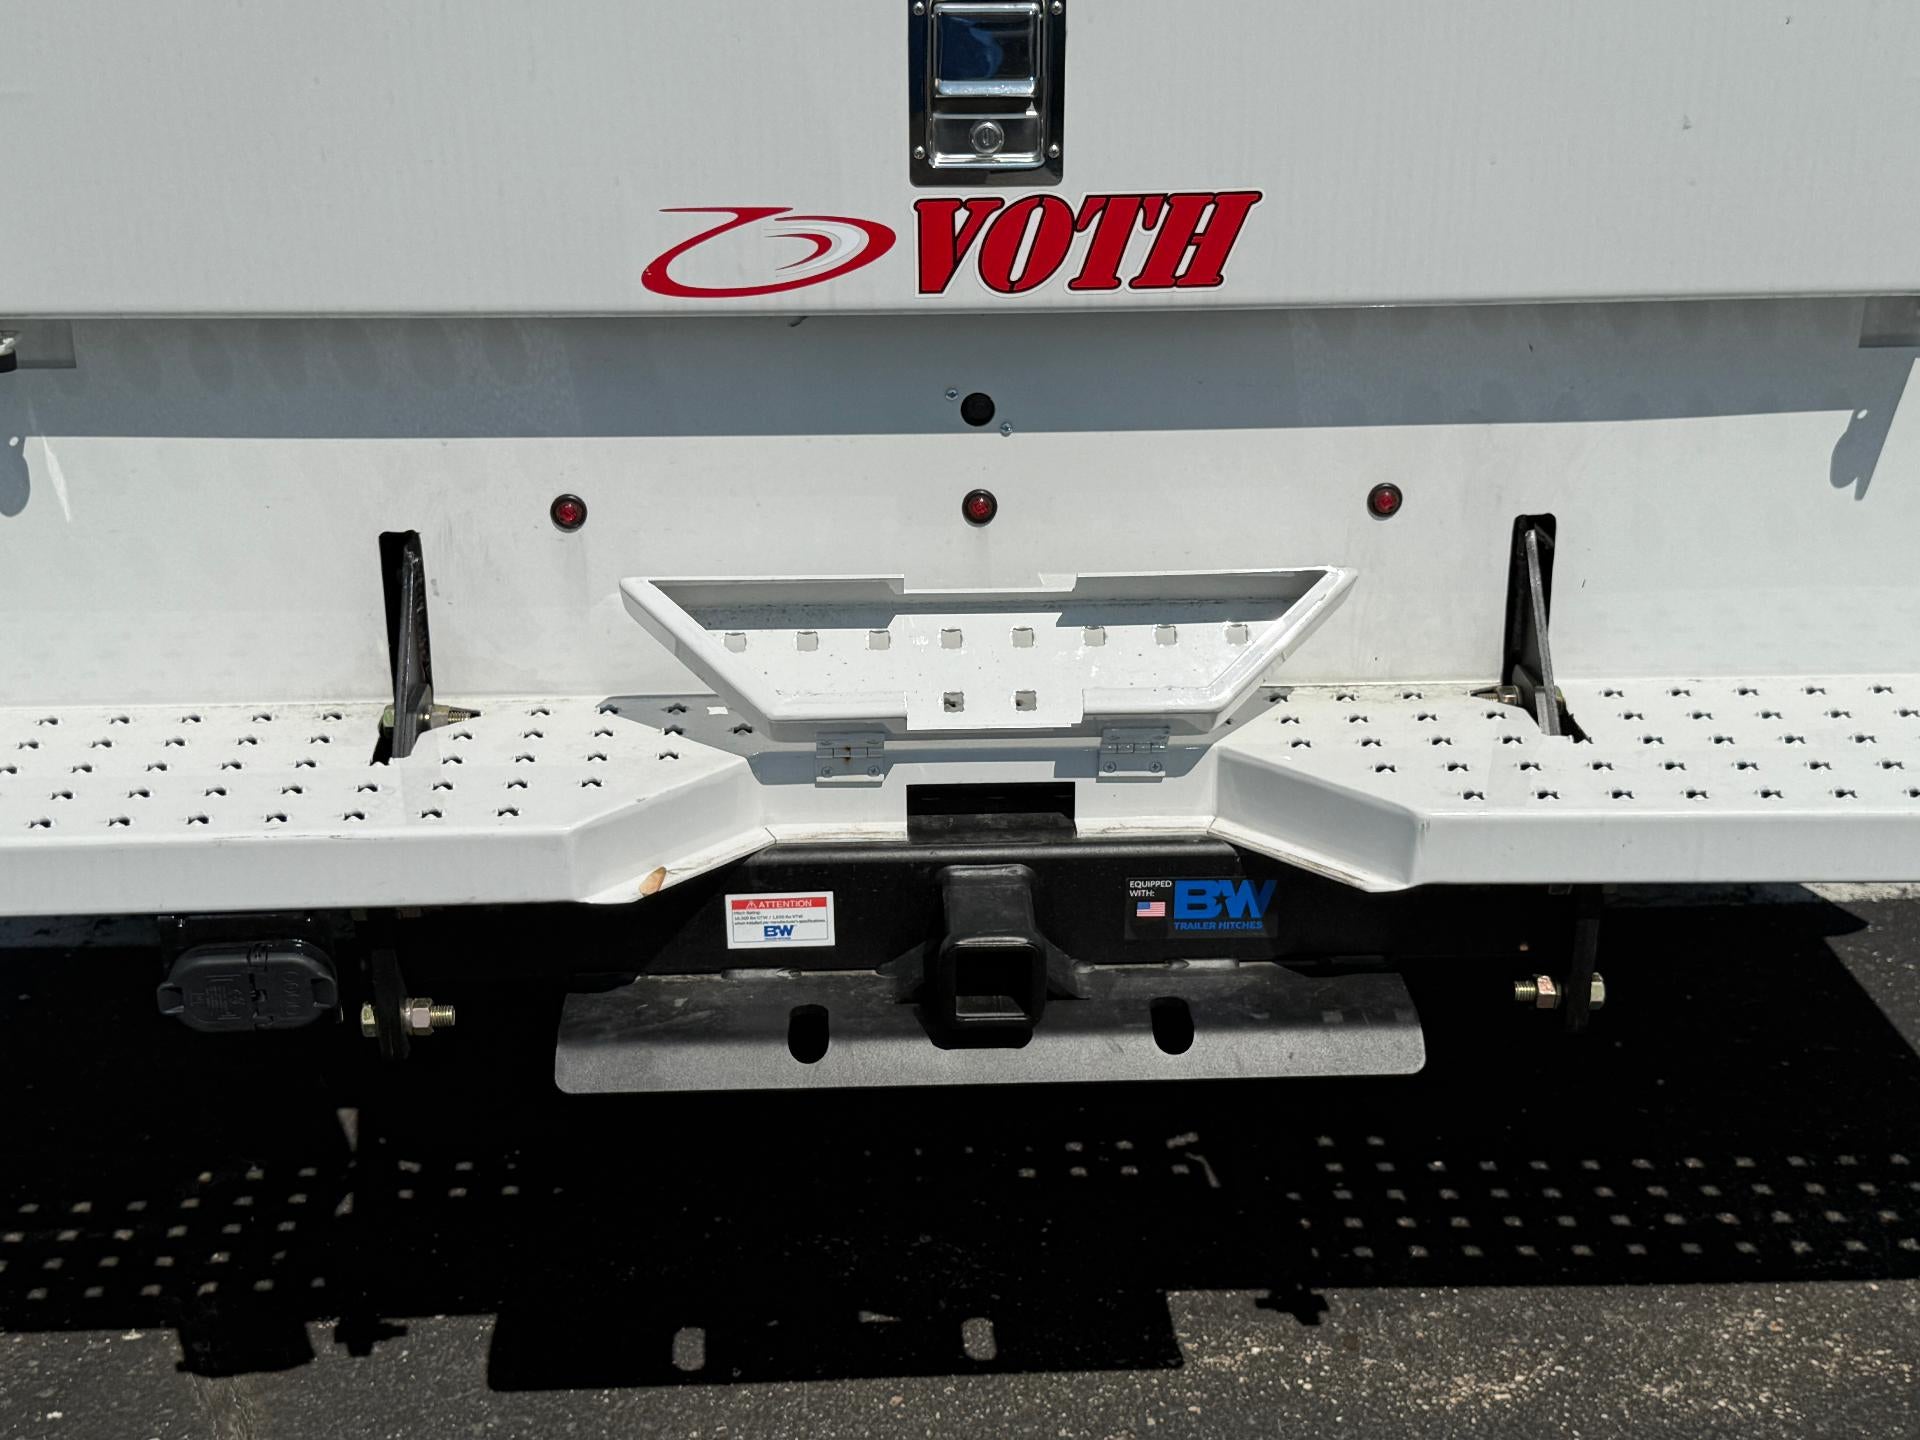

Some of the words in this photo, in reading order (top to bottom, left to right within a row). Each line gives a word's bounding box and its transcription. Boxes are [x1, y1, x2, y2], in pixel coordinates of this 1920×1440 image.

[915, 190, 1262, 294] VOTH
[1129, 880, 1172, 888] EQUIPPED
[1129, 889, 1155, 897] WITH:
[758, 899, 812, 908] ATTENTION
[1174, 921, 1216, 930] TRAILER
[1218, 920, 1263, 929] HITCHES
